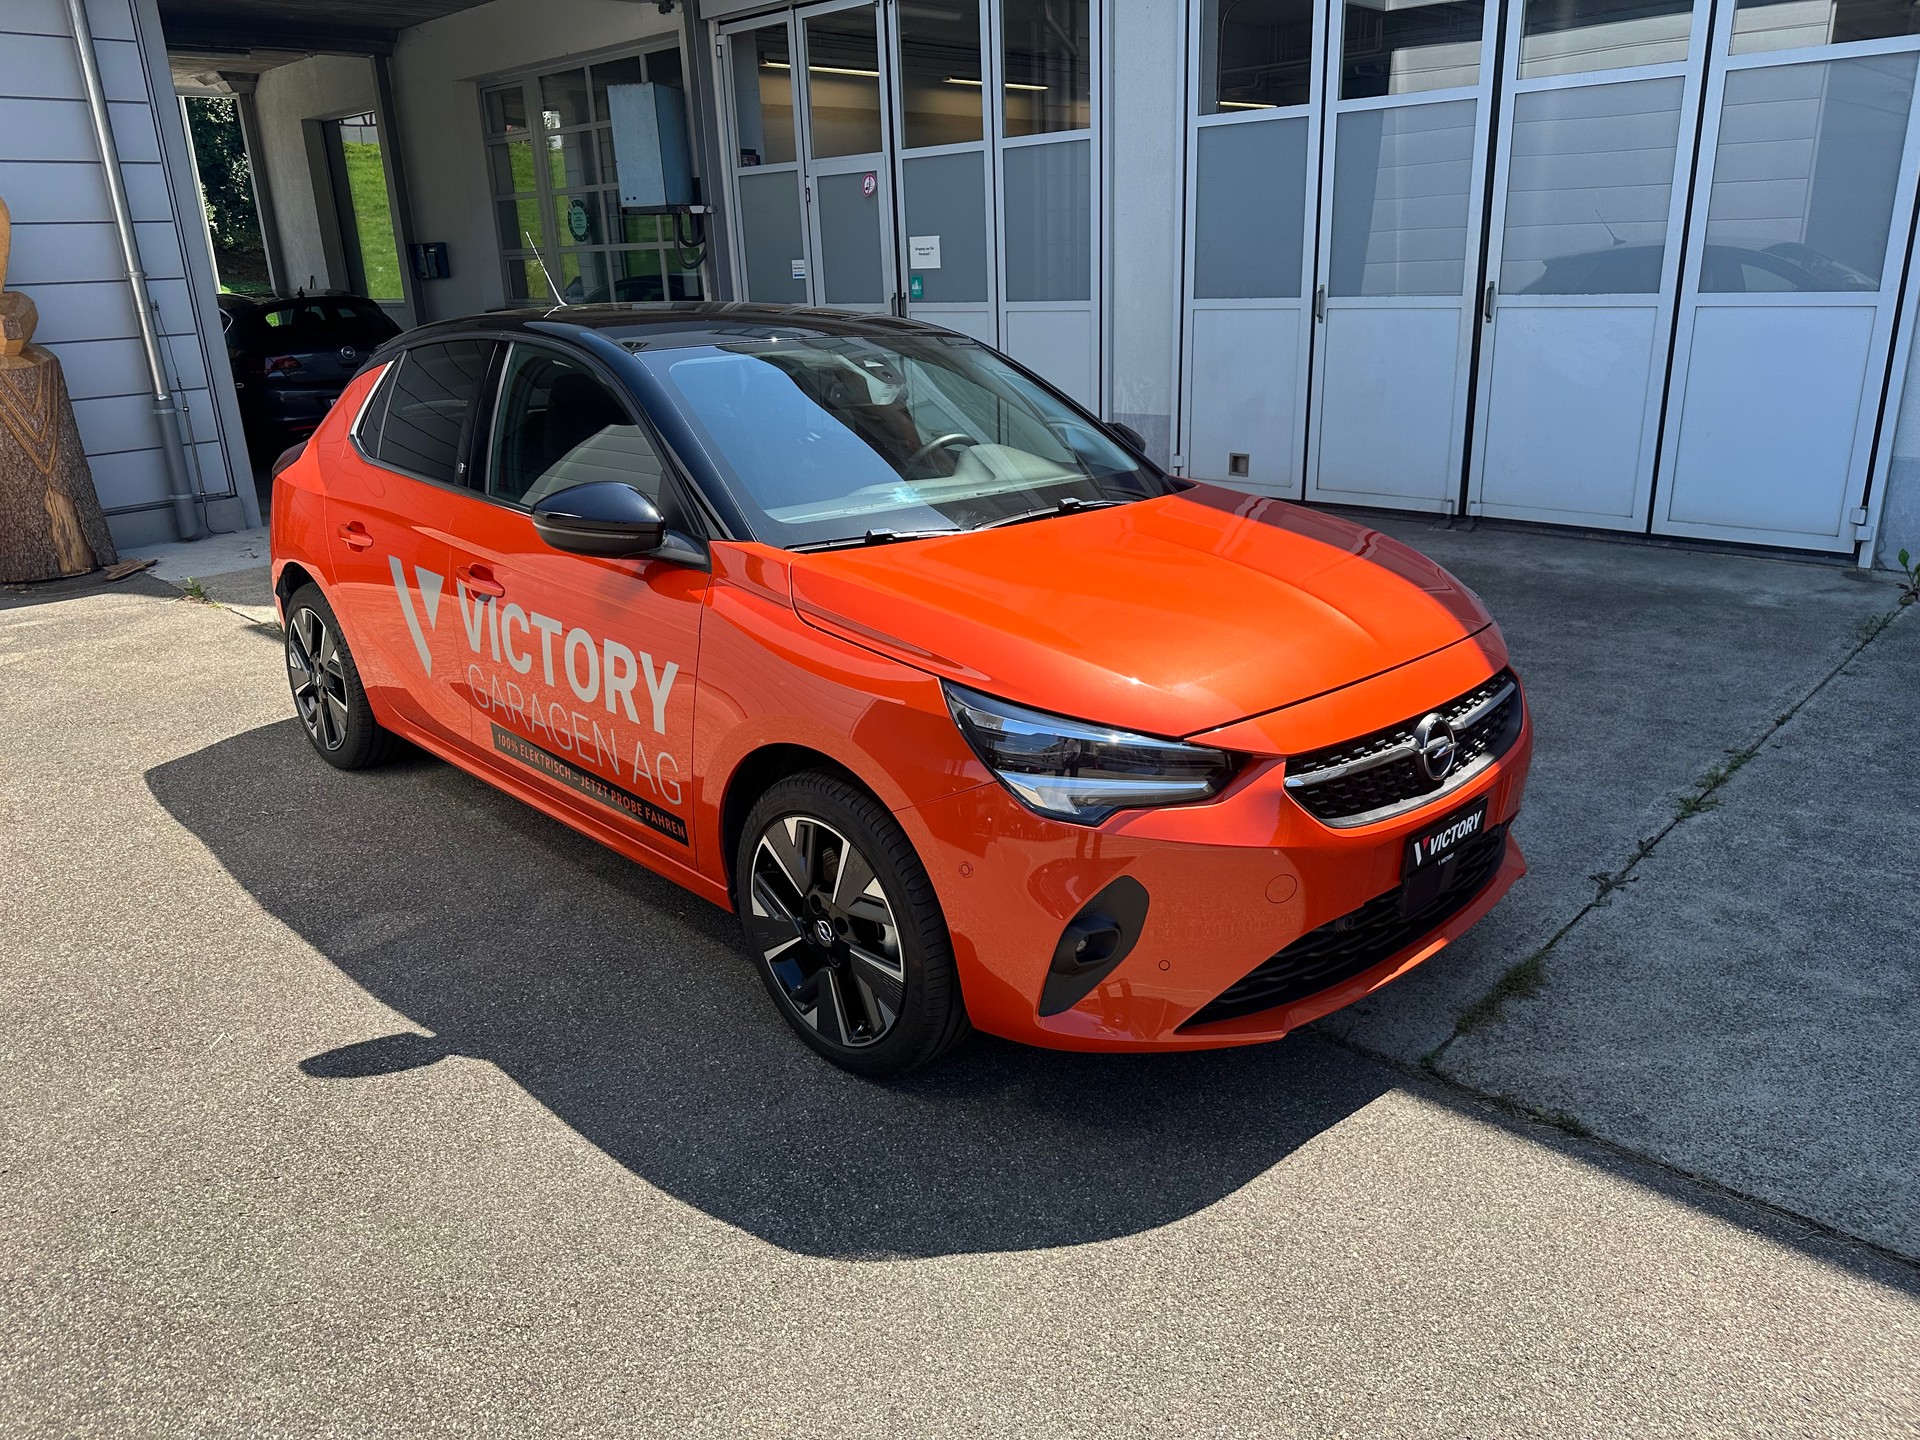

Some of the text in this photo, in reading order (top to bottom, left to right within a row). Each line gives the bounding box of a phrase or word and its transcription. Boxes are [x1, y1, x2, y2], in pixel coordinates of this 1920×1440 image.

[457, 580, 679, 735] VICTORY
[468, 664, 682, 805] GARAGEN AG
[498, 733, 519, 753] 100%
[520, 744, 571, 780] ELEKTRISCH
[581, 775, 608, 798] JETZT
[611, 789, 643, 817] PROBE
[645, 806, 686, 839] FAHREN
[1430, 810, 1482, 855] VICTORY
